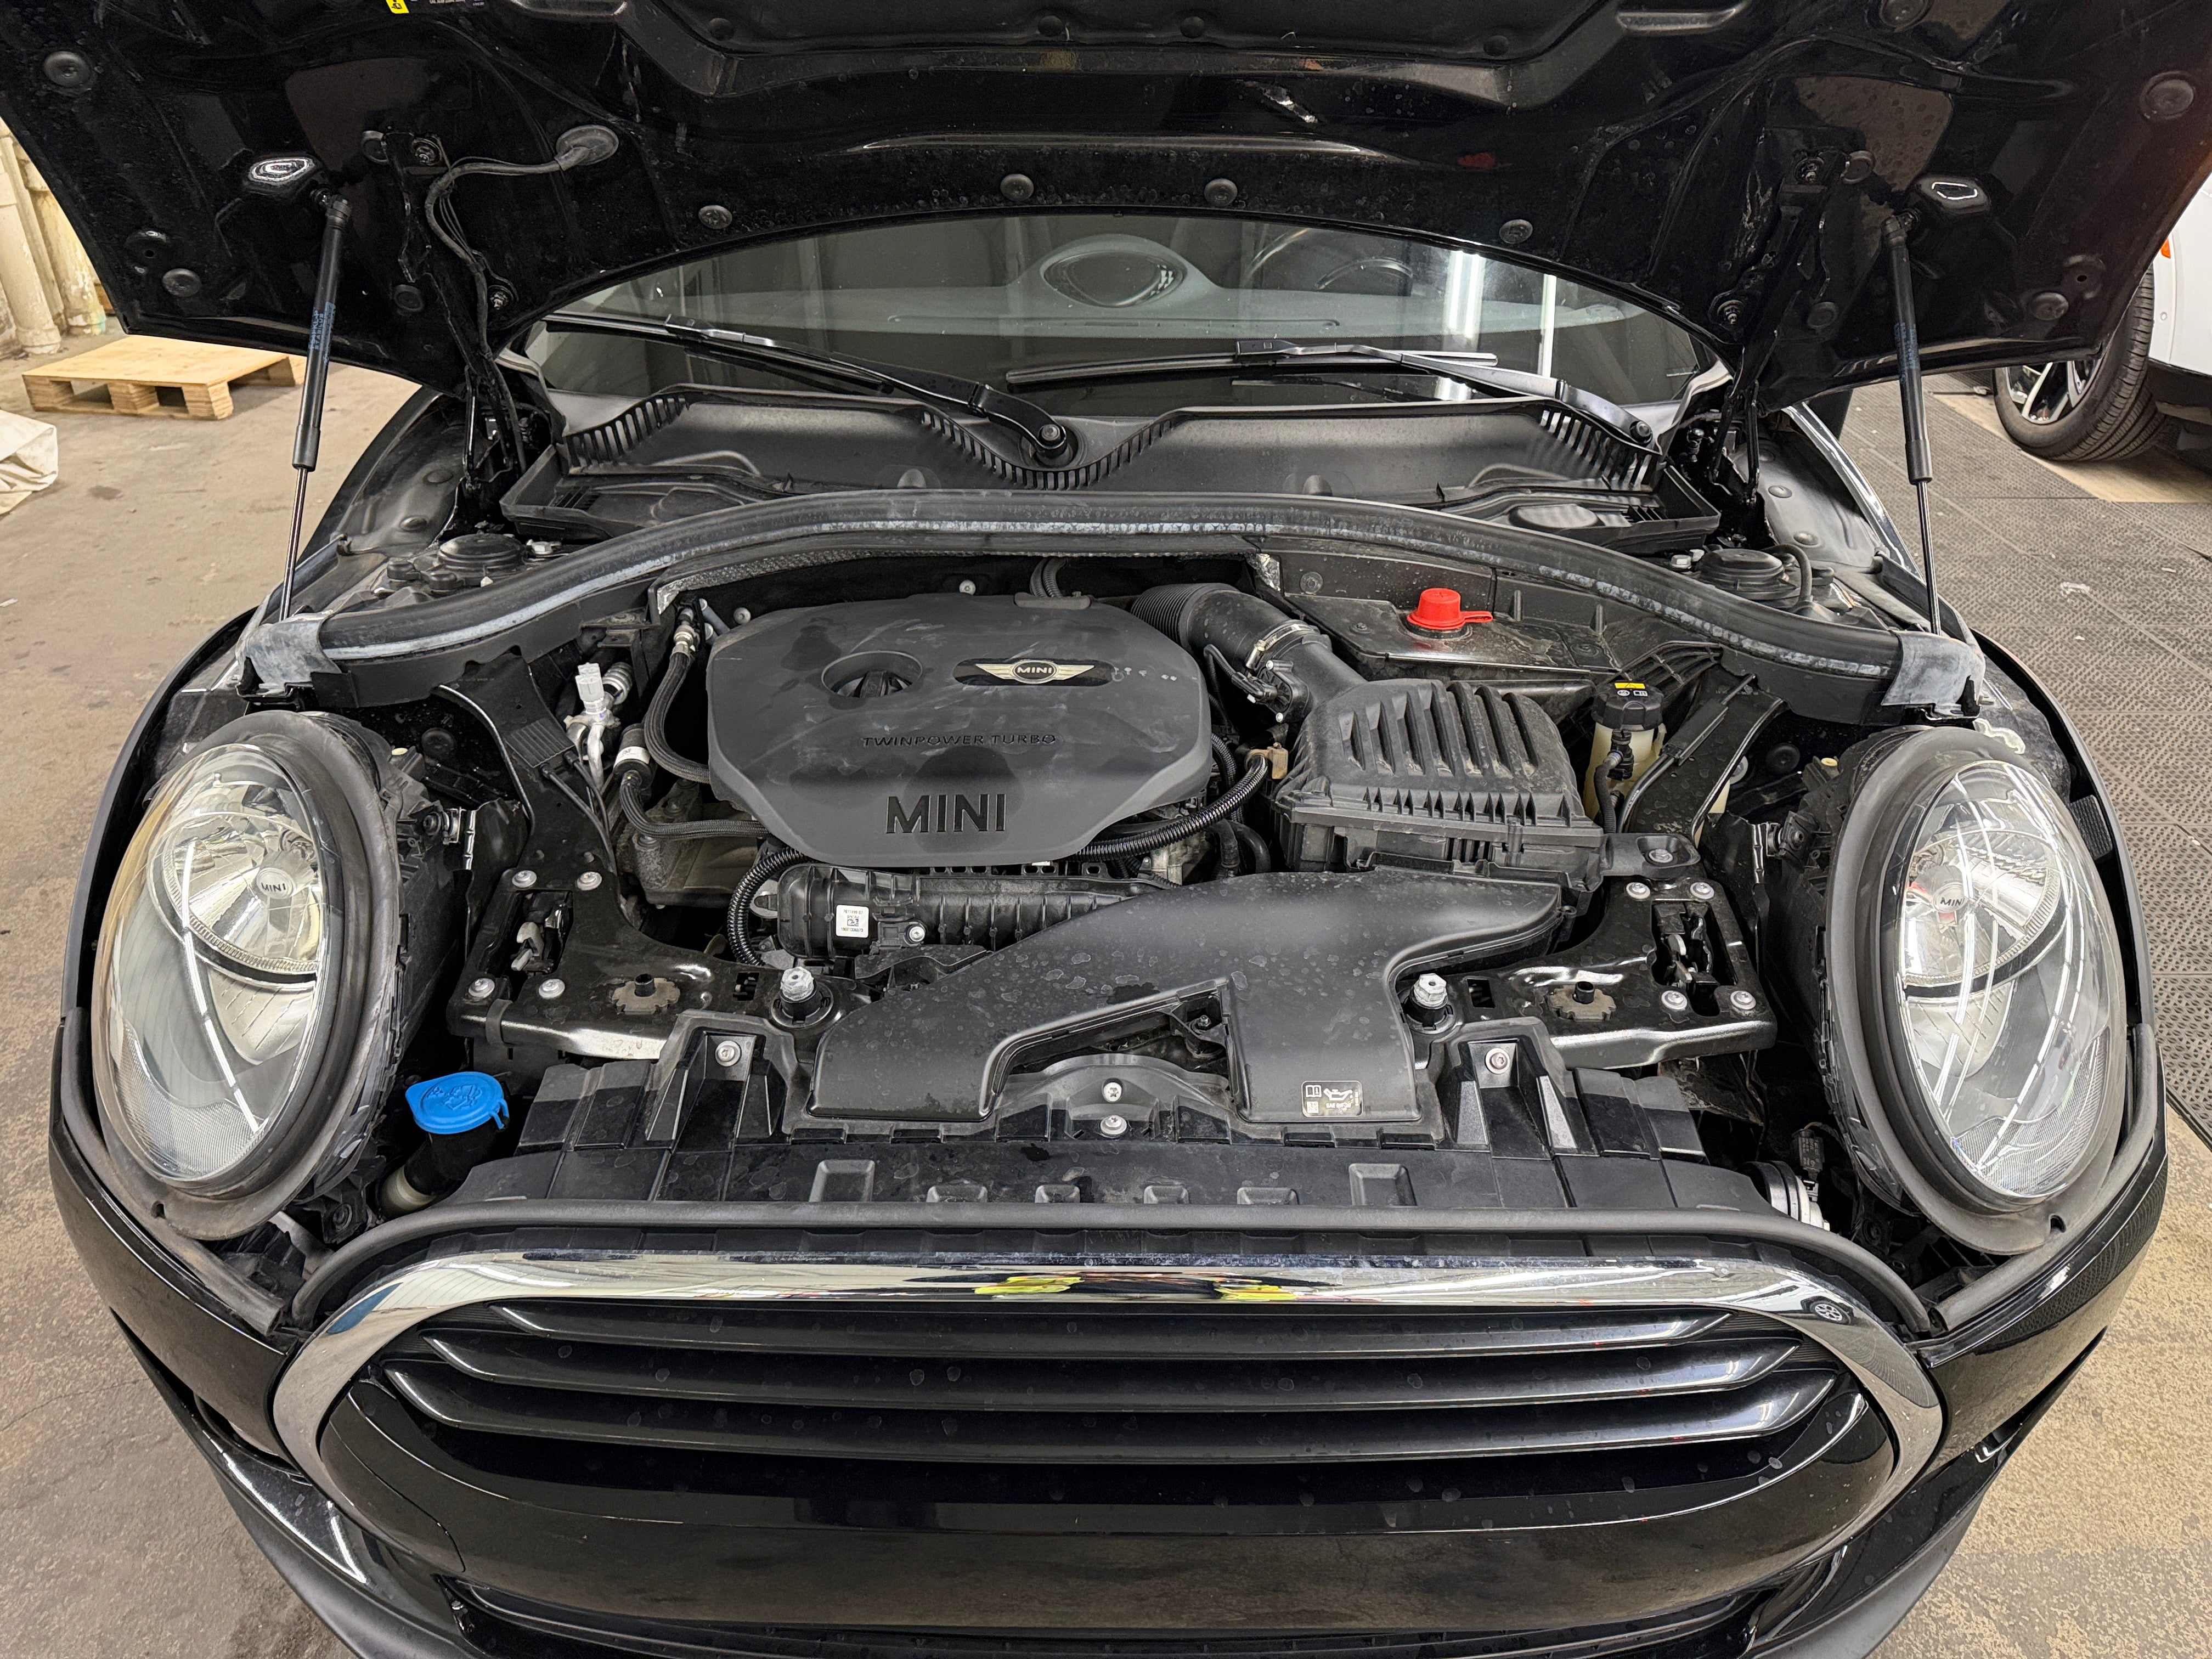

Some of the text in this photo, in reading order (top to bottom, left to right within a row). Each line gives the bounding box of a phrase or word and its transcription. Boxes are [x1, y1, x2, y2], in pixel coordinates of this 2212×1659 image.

[863, 733, 1057, 747] TWINPOWER TURBO
[885, 793, 1007, 834] MINI
[261, 882, 286, 892] MINI
